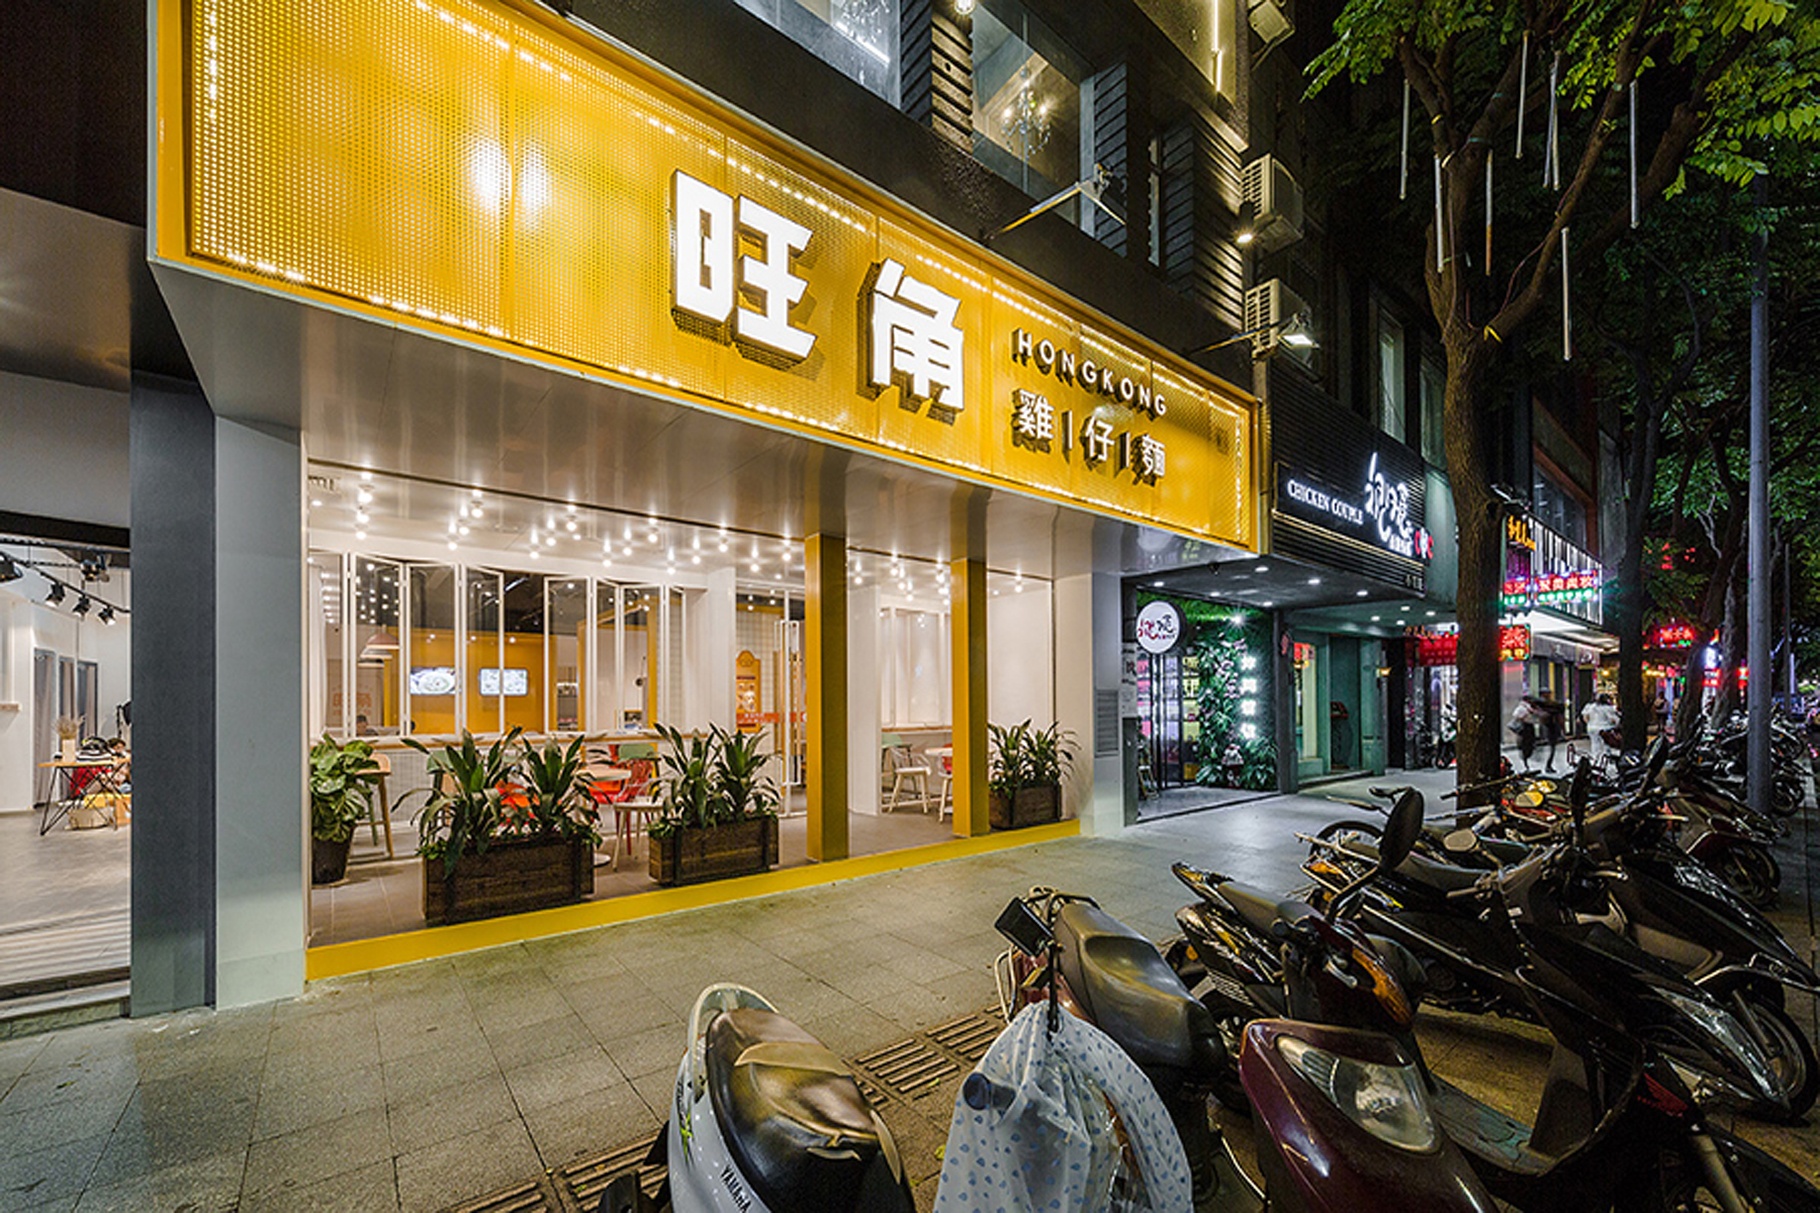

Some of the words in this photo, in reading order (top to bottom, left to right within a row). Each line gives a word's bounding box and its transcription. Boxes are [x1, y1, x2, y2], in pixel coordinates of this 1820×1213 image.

[673, 169, 965, 411] 旺角
[1017, 328, 1167, 417] HONGKONG
[1287, 479, 1330, 512] CHICKEN
[1331, 498, 1364, 525] COUPLE
[720, 1163, 752, 1213] YAMAHA
